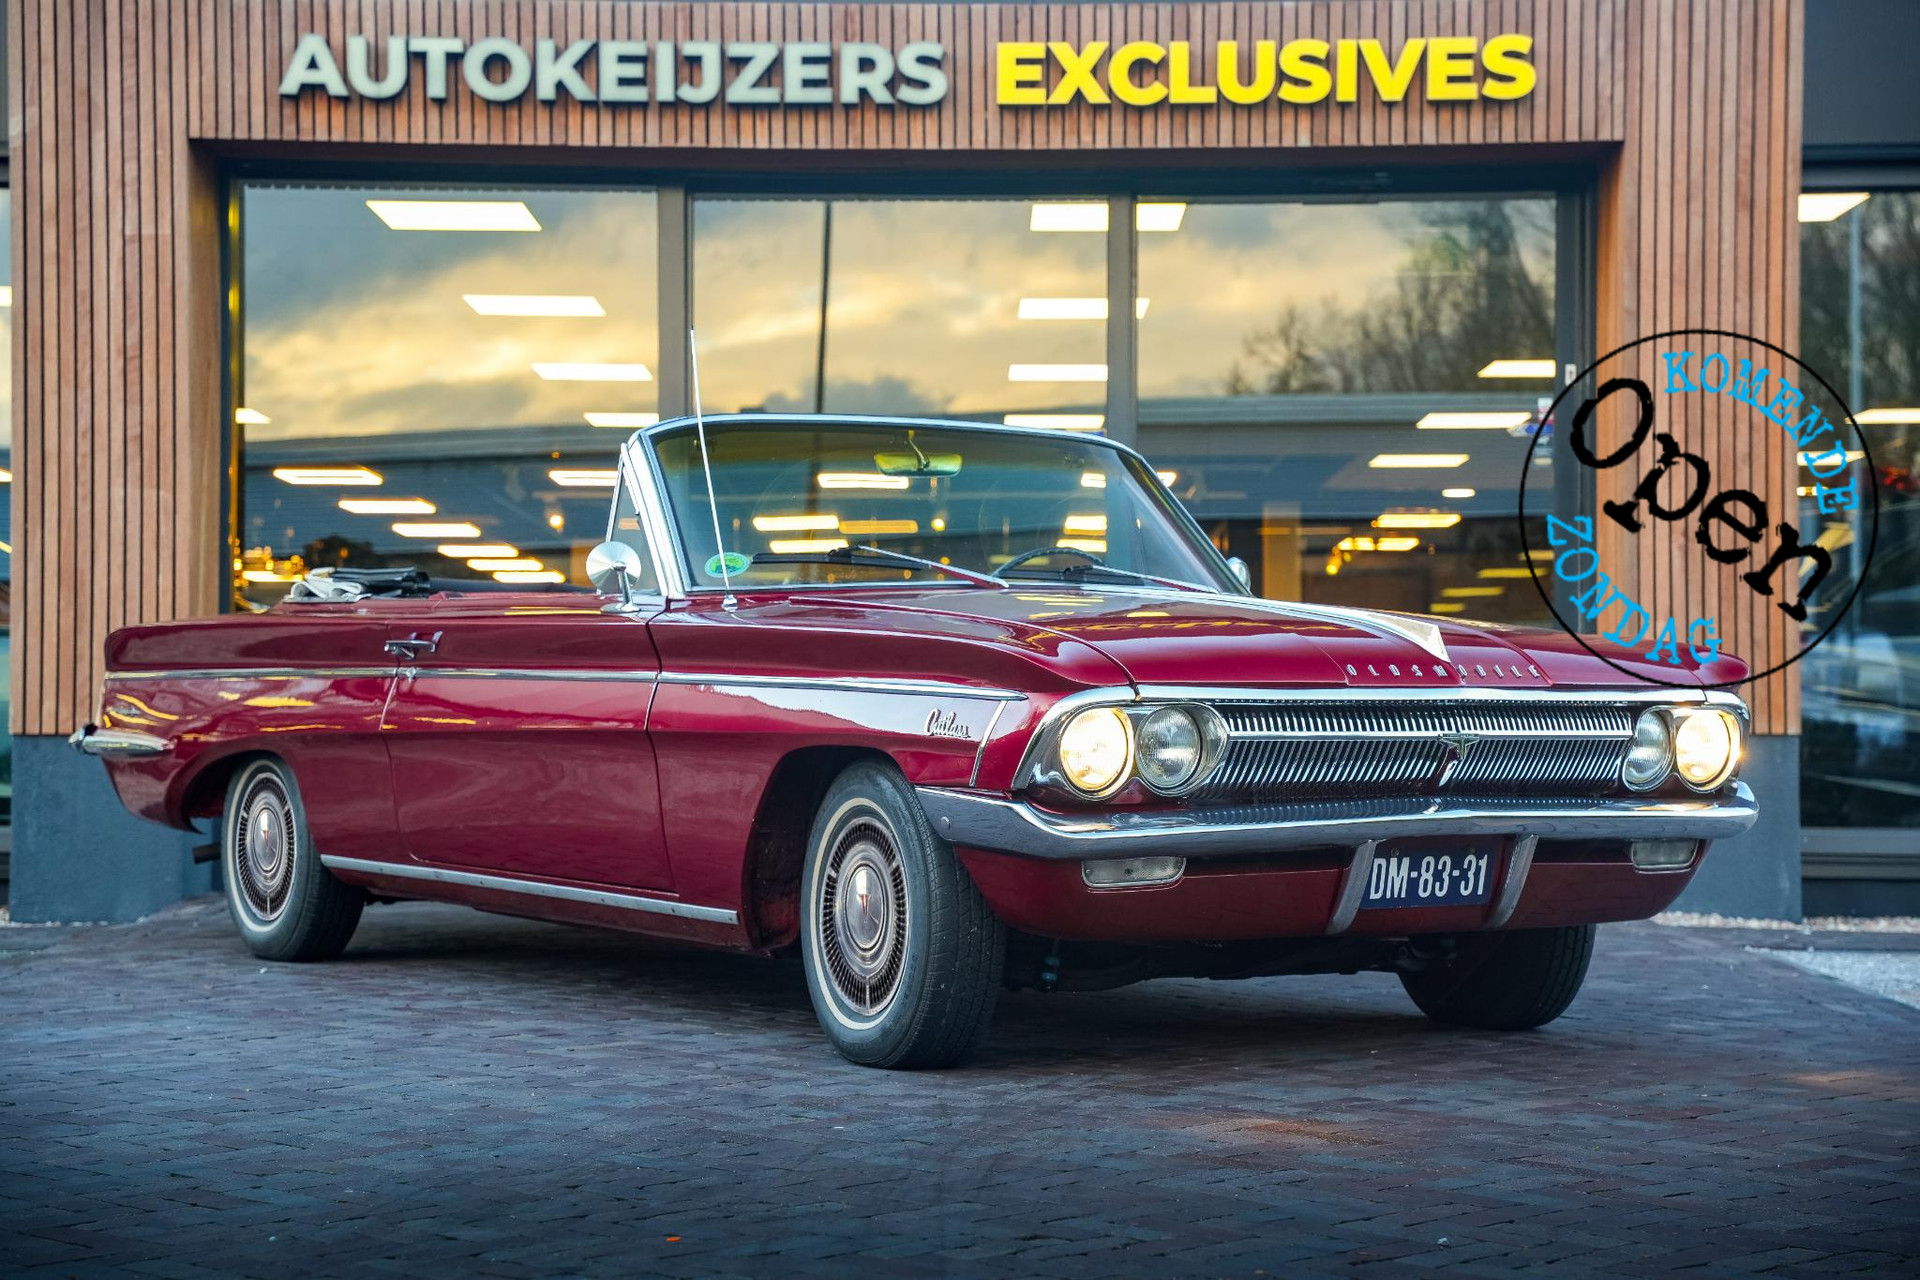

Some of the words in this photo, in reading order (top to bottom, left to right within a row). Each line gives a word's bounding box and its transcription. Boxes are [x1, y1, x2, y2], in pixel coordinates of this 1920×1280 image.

[279, 33, 949, 106] AUTOKEIJZERS
[996, 34, 1537, 106] EXCLUSIVES
[1345, 664, 1541, 679] OLDSMOBILE
[1369, 854, 1488, 899] DM-83-31
